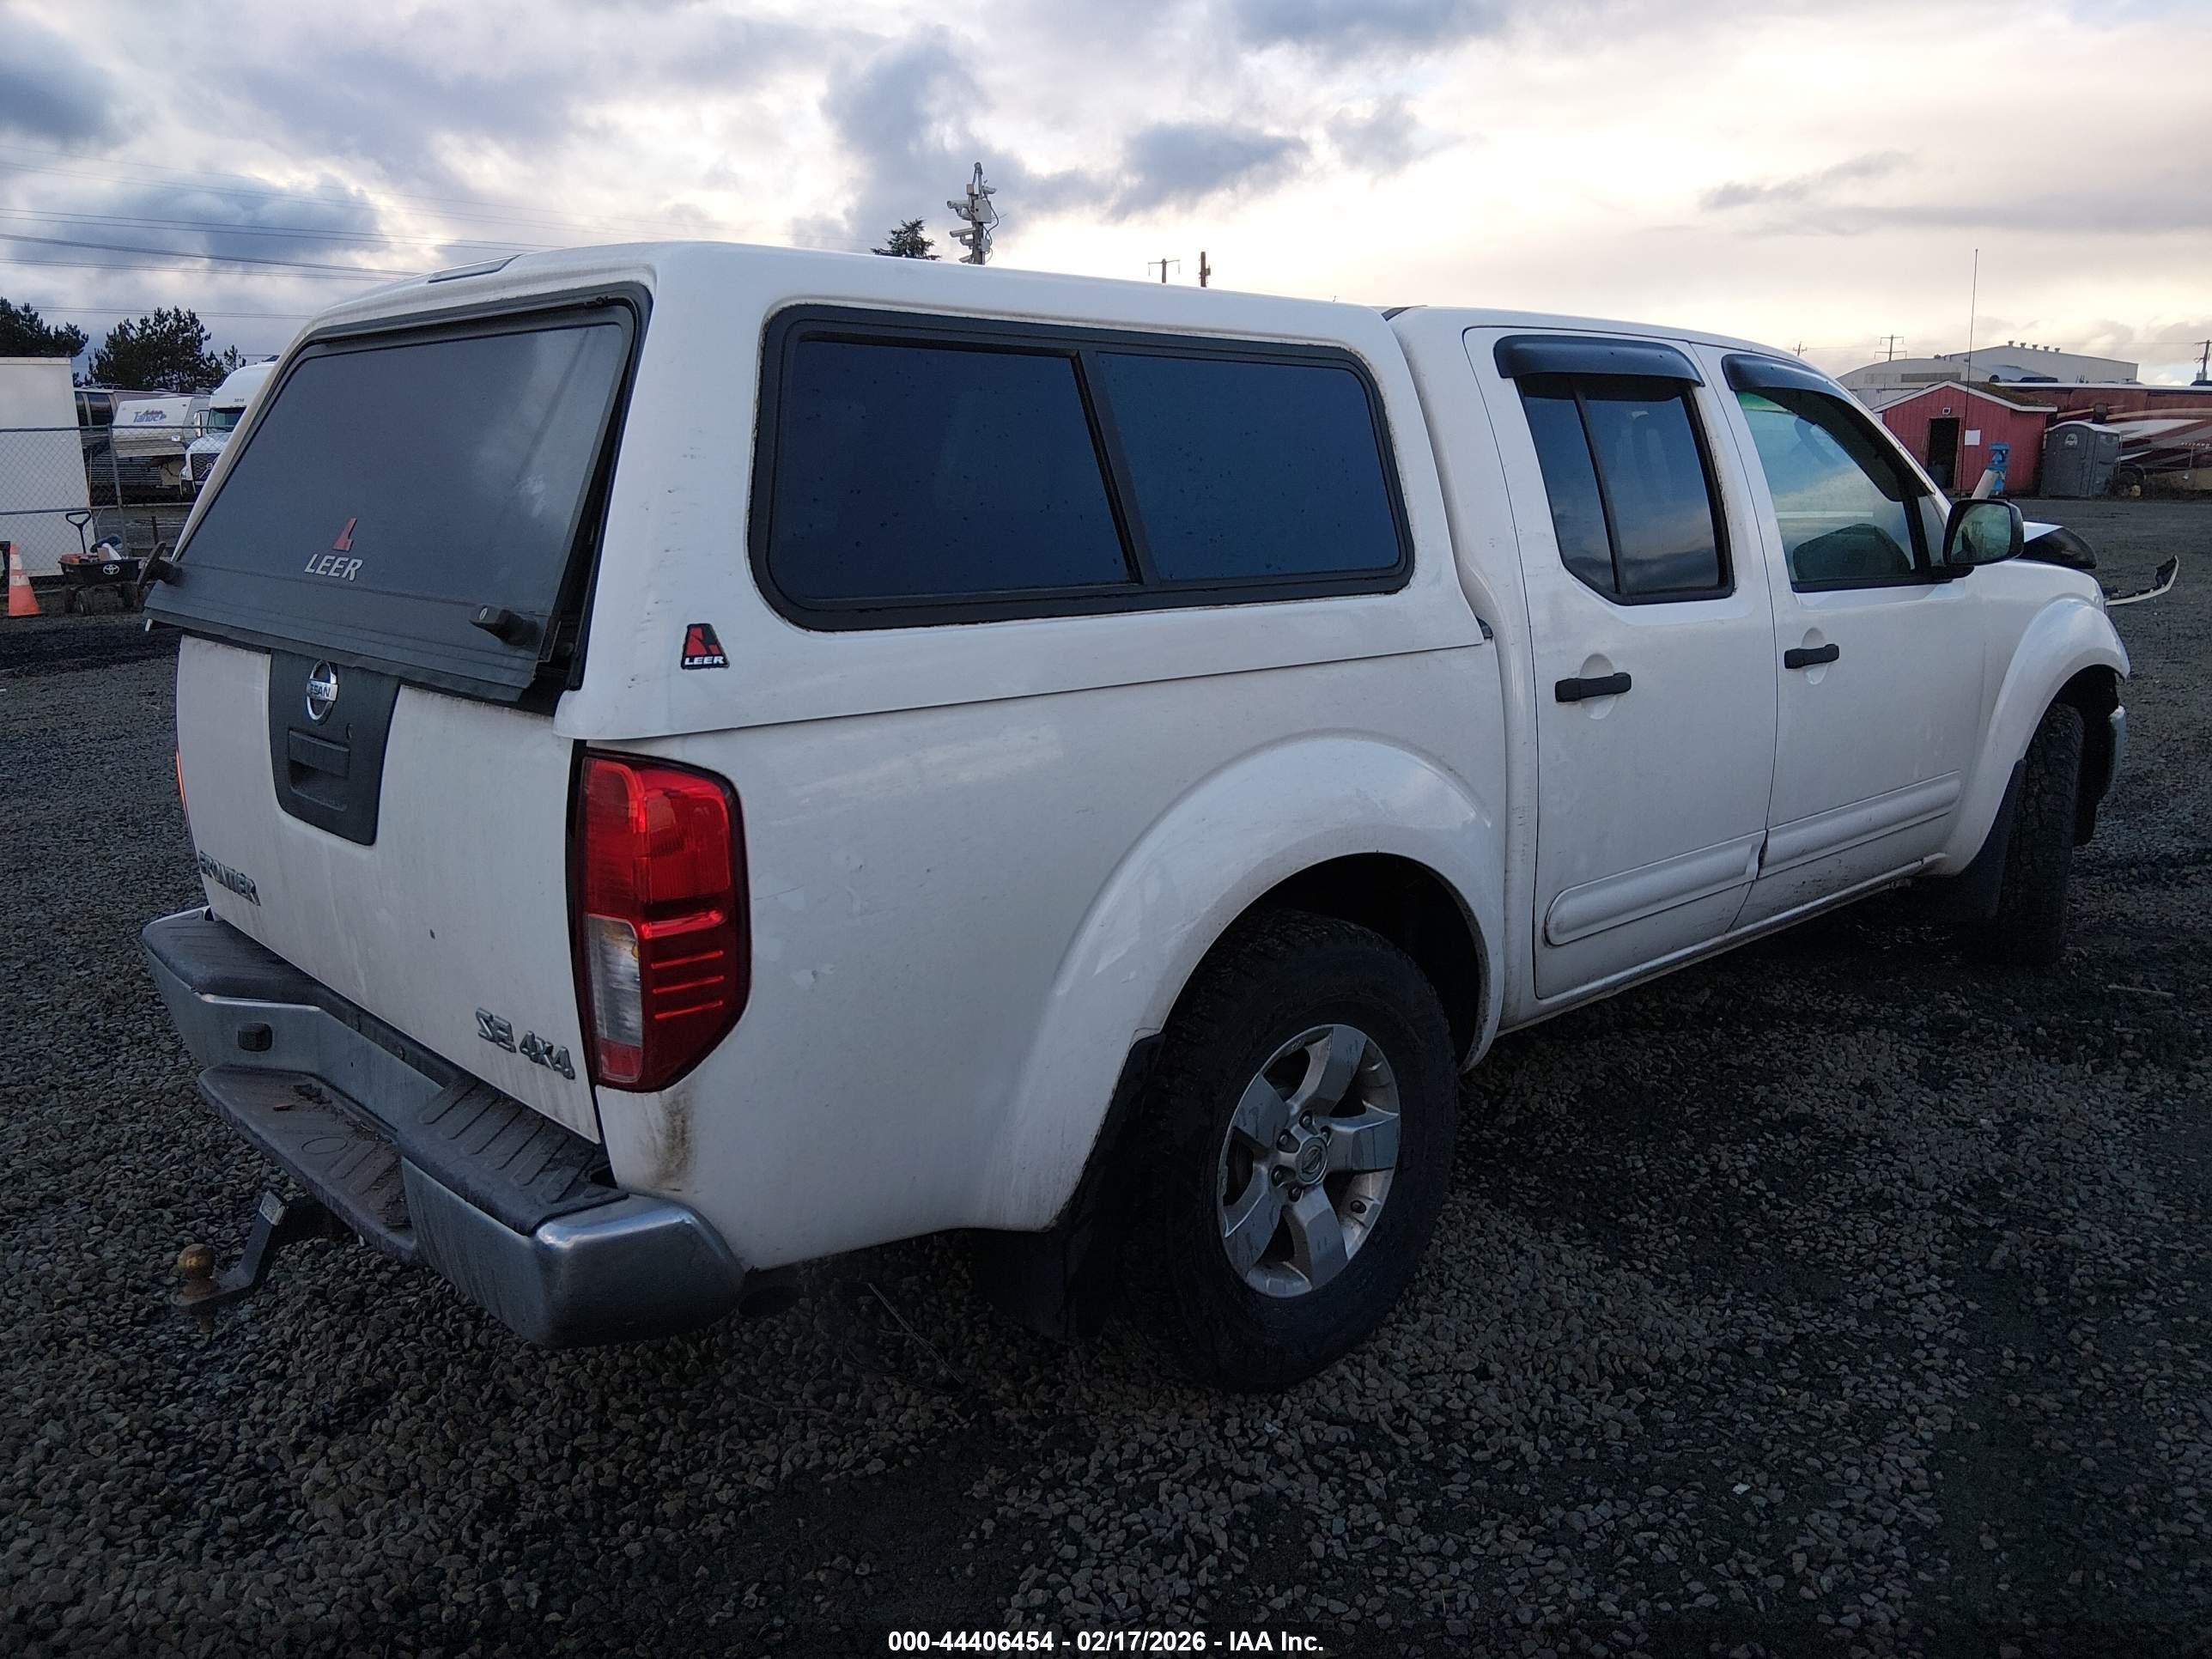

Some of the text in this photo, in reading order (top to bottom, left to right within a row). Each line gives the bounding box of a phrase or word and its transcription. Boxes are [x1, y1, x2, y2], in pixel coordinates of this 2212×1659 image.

[304, 553, 363, 581] LEER
[684, 656, 724, 665] LEER
[476, 1007, 517, 1054] SE
